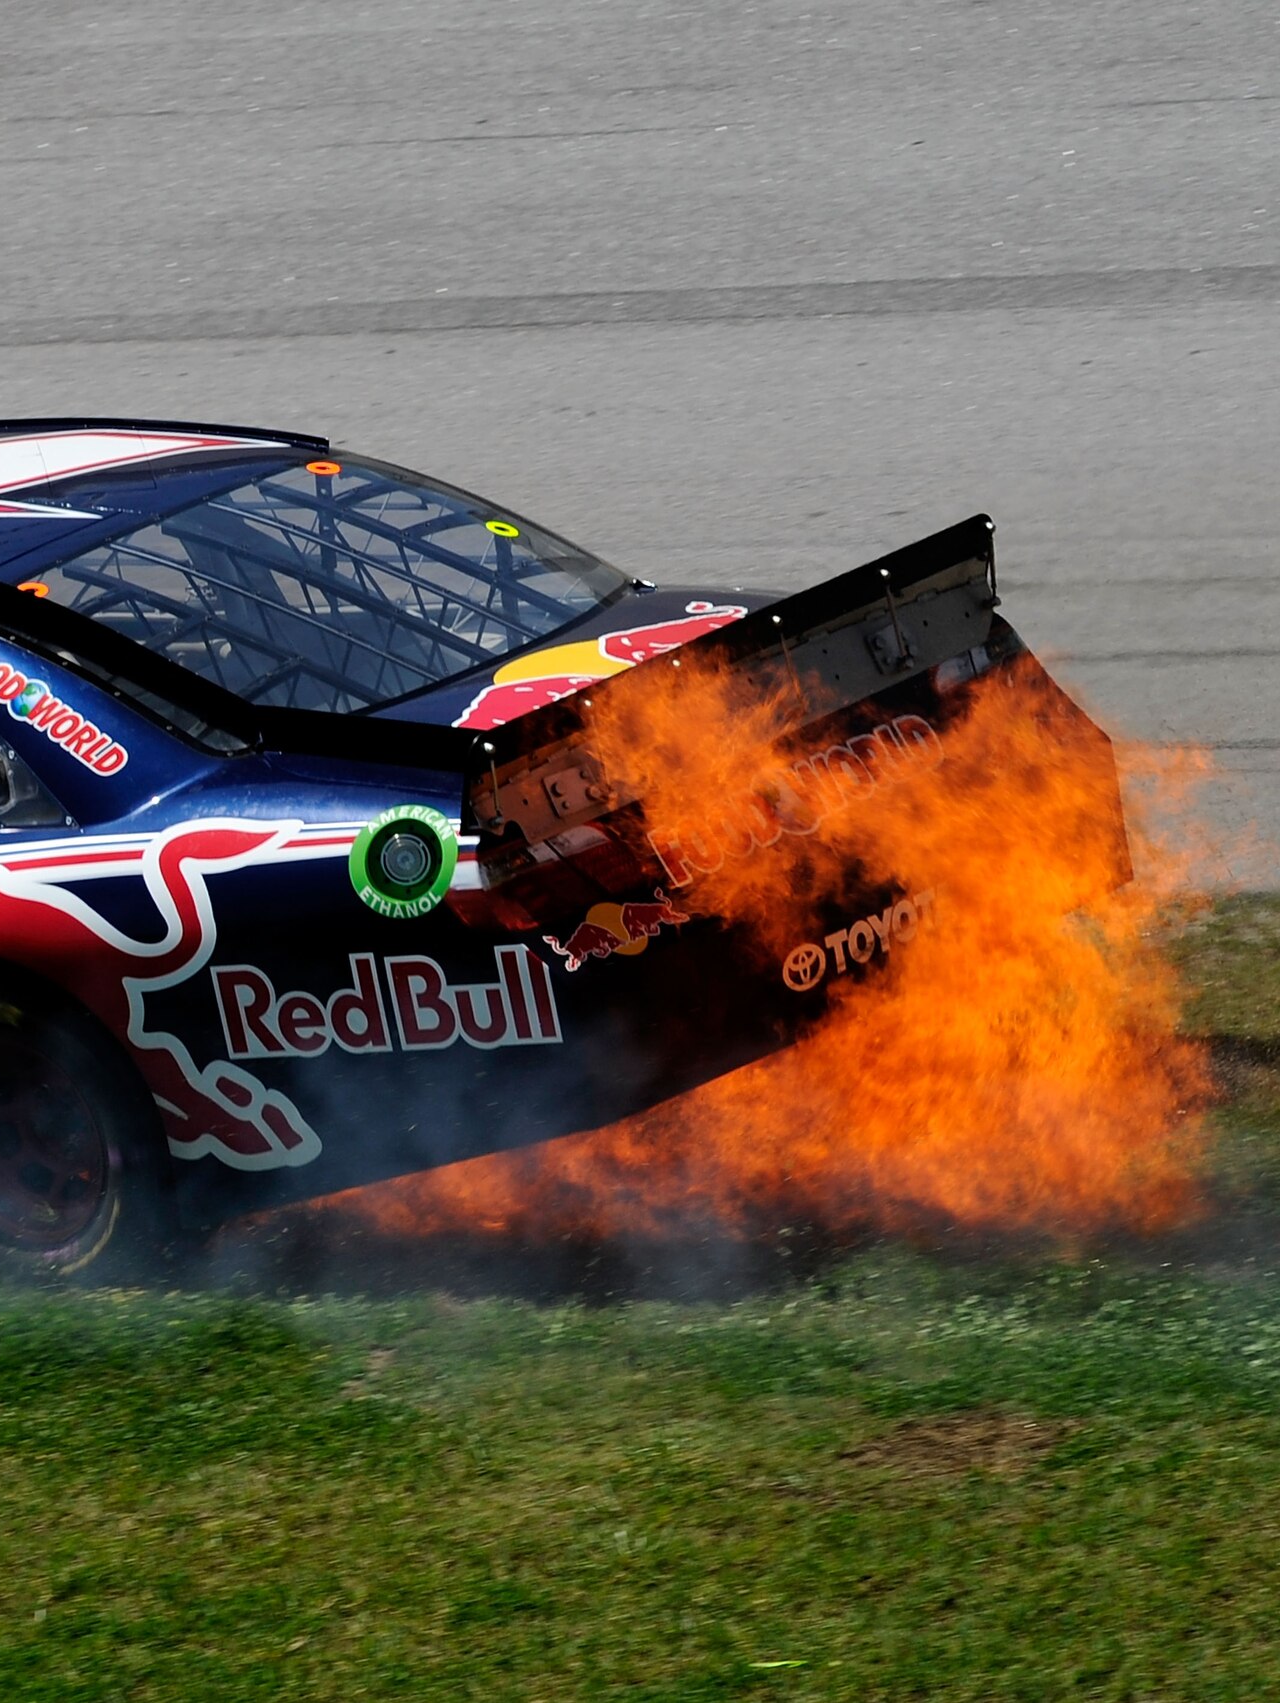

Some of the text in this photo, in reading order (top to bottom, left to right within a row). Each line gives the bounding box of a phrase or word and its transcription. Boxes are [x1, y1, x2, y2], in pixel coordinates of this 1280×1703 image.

[26, 694, 128, 775] WORLD
[367, 805, 454, 840] AMERICAN
[359, 886, 442, 919] ETHANOL
[824, 889, 939, 974] TOYOT
[211, 945, 563, 1059] Red Bull
